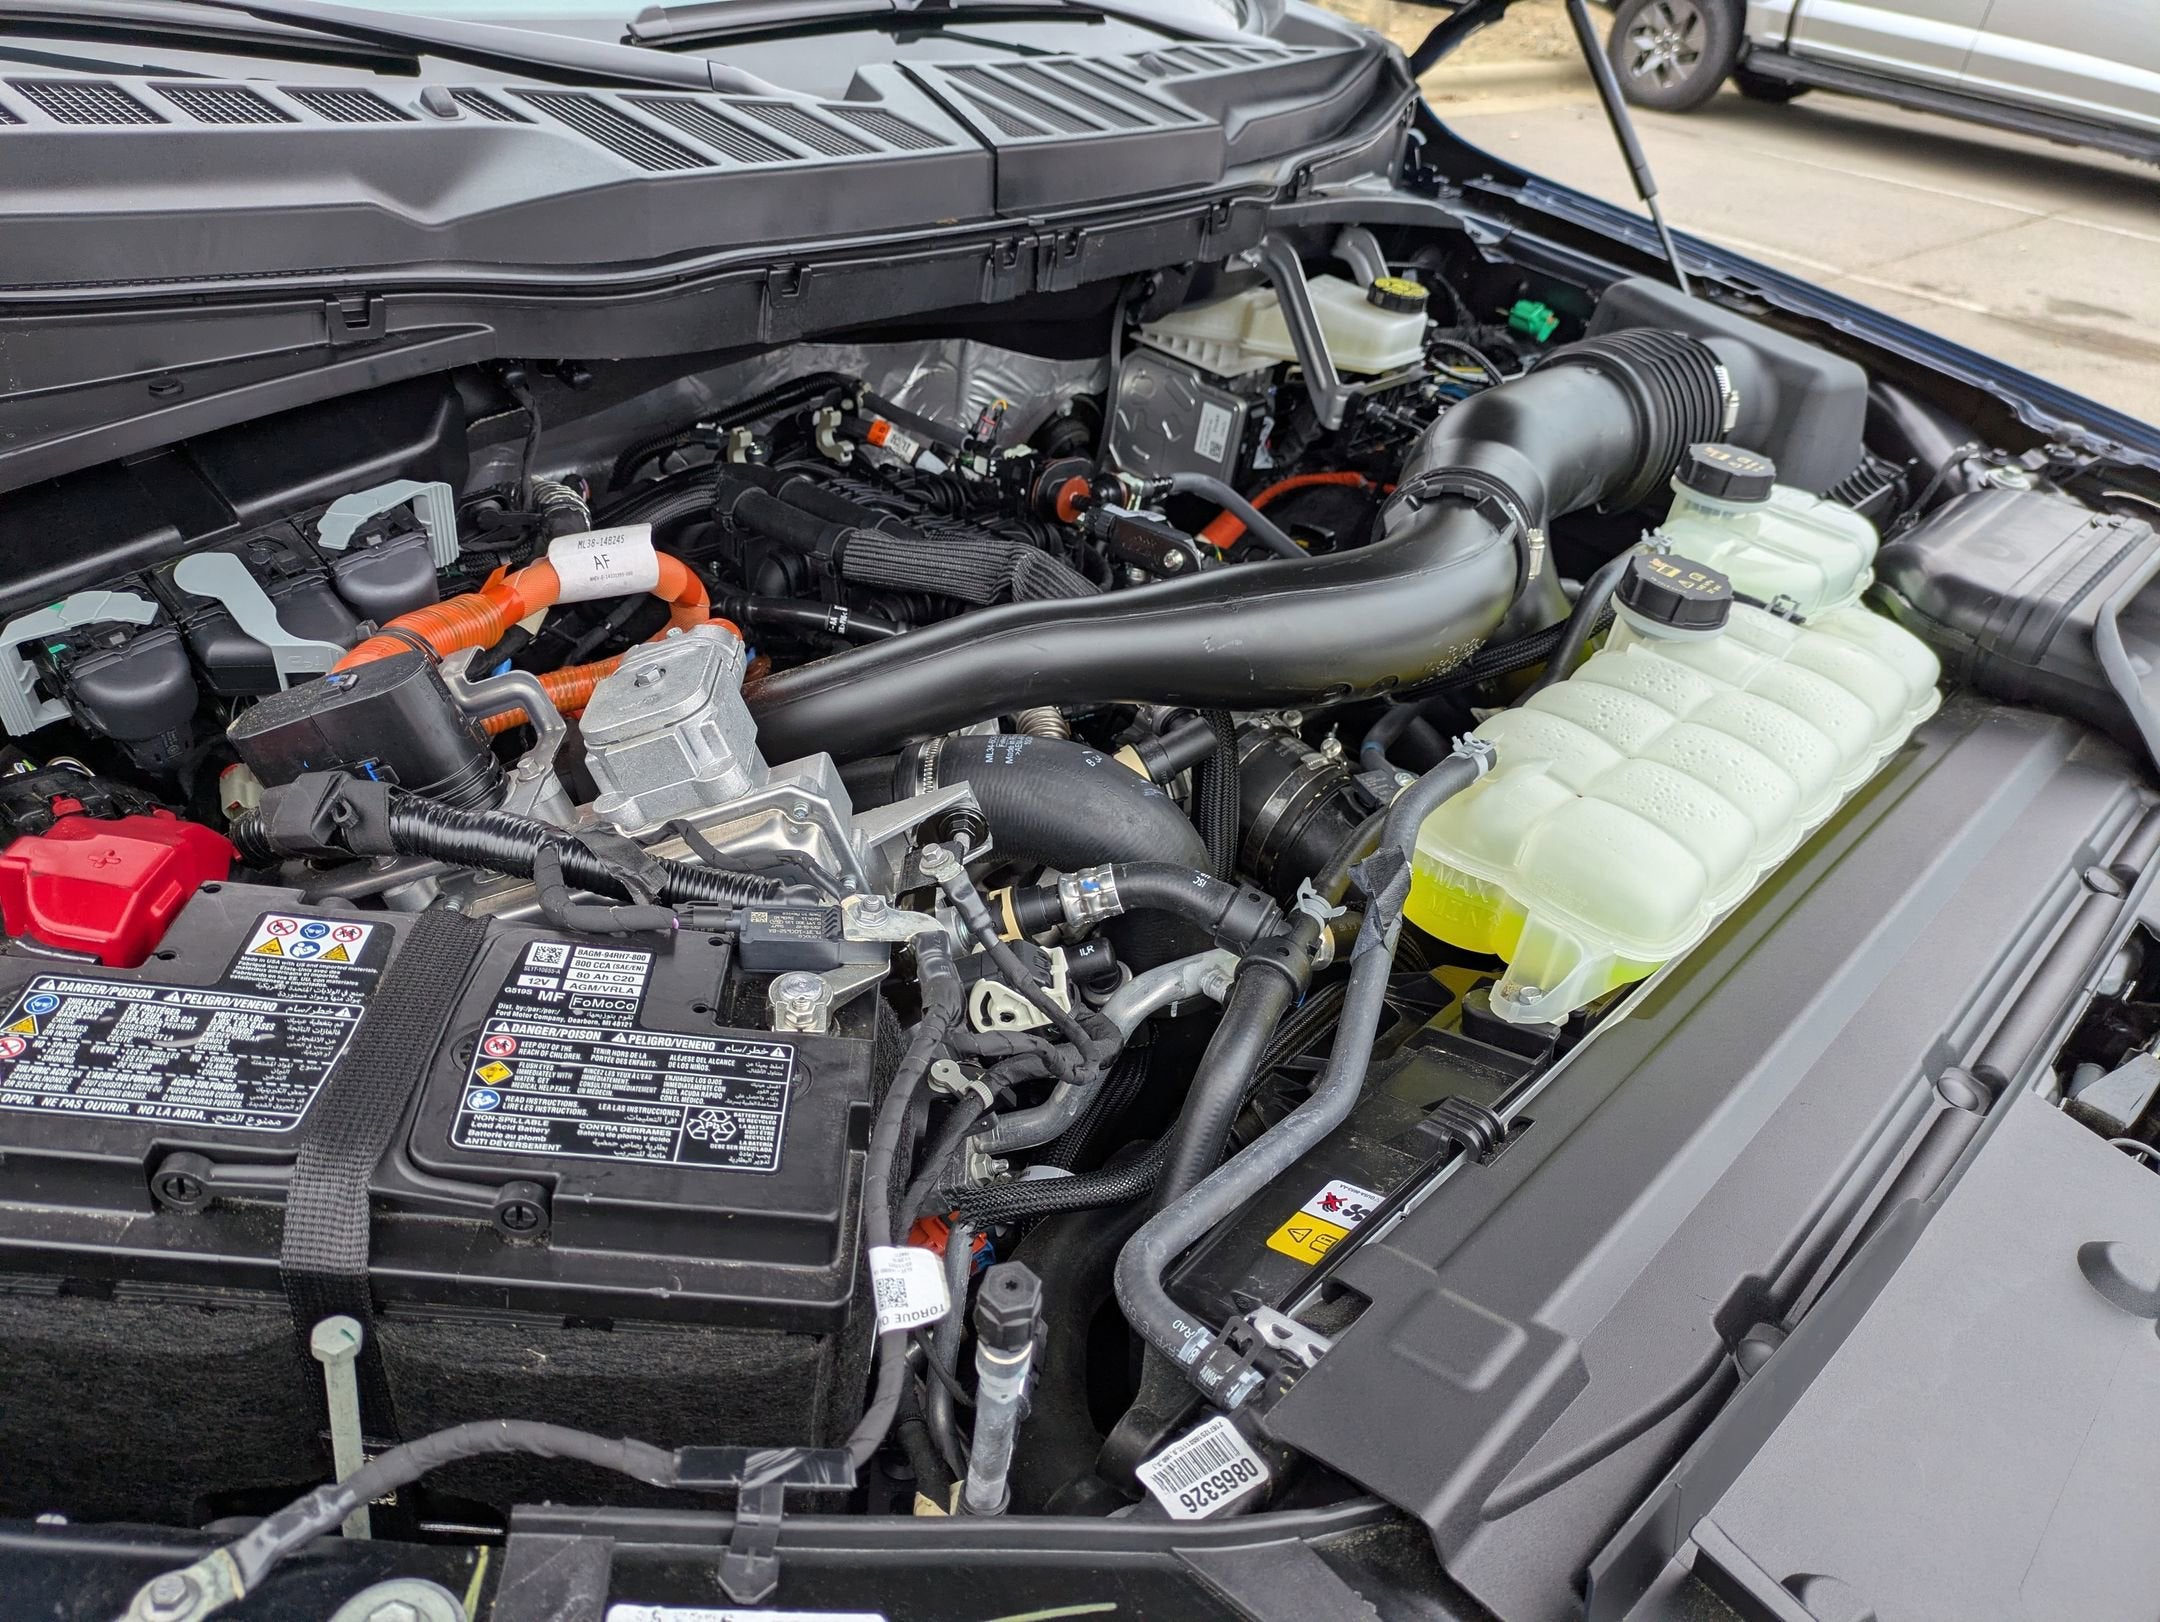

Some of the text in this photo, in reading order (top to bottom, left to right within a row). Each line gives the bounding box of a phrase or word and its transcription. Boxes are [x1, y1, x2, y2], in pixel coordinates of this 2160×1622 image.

[594, 554, 610, 570] AF
[578, 949, 646, 961] 8AGM-94RH7-800
[593, 962, 611, 970] CCA
[613, 964, 644, 972] (SAE/EN)
[613, 974, 635, 983] C20
[57, 982, 156, 999] DANGER/POISON
[569, 983, 634, 994] AGM/VRLA
[67, 997, 94, 1007] SHIELD
[538, 991, 566, 1002] MF
[182, 993, 278, 1012] PELIGRO/VENENO
[572, 997, 635, 1011] FoMoCo
[61, 1003, 105, 1014] EXPLOSIVE
[52, 1016, 75, 1024] CAUSE
[57, 1010, 83, 1019] GASES
[214, 1012, 264, 1022] PROTEJA LOS
[46, 1023, 88, 1032] BLINDNESS
[116, 1023, 146, 1032] CAUSER
[120, 1016, 196, 1031] EXPLOSIFS PEUVENT
[511, 1024, 601, 1041] DANGER/POISON
[33, 1040, 80, 1050] NO SPARKS
[521, 1040, 537, 1048] KEEP
[538, 1042, 550, 1050] OUT
[561, 1044, 572, 1052] THE
[628, 1034, 716, 1051] PELIGRO/VENENO
[47, 1049, 75, 1057] FLAMES
[518, 1048, 539, 1057] REACH
[592, 1047, 612, 1055] TENIR
[613, 1048, 629, 1057] HORS
[640, 1052, 647, 1060] LA
[42, 1055, 75, 1063] SMOKING
[134, 1056, 169, 1065] FLAMMES
[189, 1054, 239, 1065] NO CHISPAS
[670, 1053, 694, 1063] ALÉJESE
[708, 1057, 736, 1066] ALCANCE
[14, 1064, 82, 1078] SULFURIC ACID CAN
[519, 1062, 554, 1071] FLUSH EYES
[9, 1073, 73, 1084] CAUSE BLINDNESS
[115, 1073, 163, 1084] SULFURIQUE
[202, 1069, 237, 1078] CIGARROS
[516, 1069, 573, 1080] IMMEDIATELY WITH
[15, 1080, 42, 1089] SEVERE
[665, 1075, 694, 1084] ENJUAGUE
[511, 1082, 537, 1090] MEDICAL
[538, 1084, 554, 1092] HELP
[663, 1082, 712, 1091] INMEDIATAMENTE
[167, 1086, 244, 1100] PUEDE CAUSAR CEGUERA
[169, 1096, 212, 1105] QUEMADURAS
[505, 1095, 579, 1108] READ INSTRUCTIONS.
[2, 1094, 206, 1120] OPEN. NE PAS OUVRIR. NO LA ABRA.
[503, 1103, 519, 1111] LIRE
[535, 1105, 589, 1116] INSTRUCTIONS.
[598, 1103, 611, 1111] LEA
[612, 1104, 625, 1112] LAS
[474, 1114, 549, 1126] NON-SPILLABLE
[706, 1121, 720, 1130] Pb
[471, 1121, 550, 1134] Lead Acid Battery
[579, 1123, 671, 1137] CONTRA DERRAMES
[468, 1129, 502, 1138] Batterie
[518, 1134, 547, 1143] plomb
[895, 1304, 944, 1323] TORQUE
[1172, 1320, 1196, 1338] RAD
[1180, 1458, 1258, 1513] 0865326
